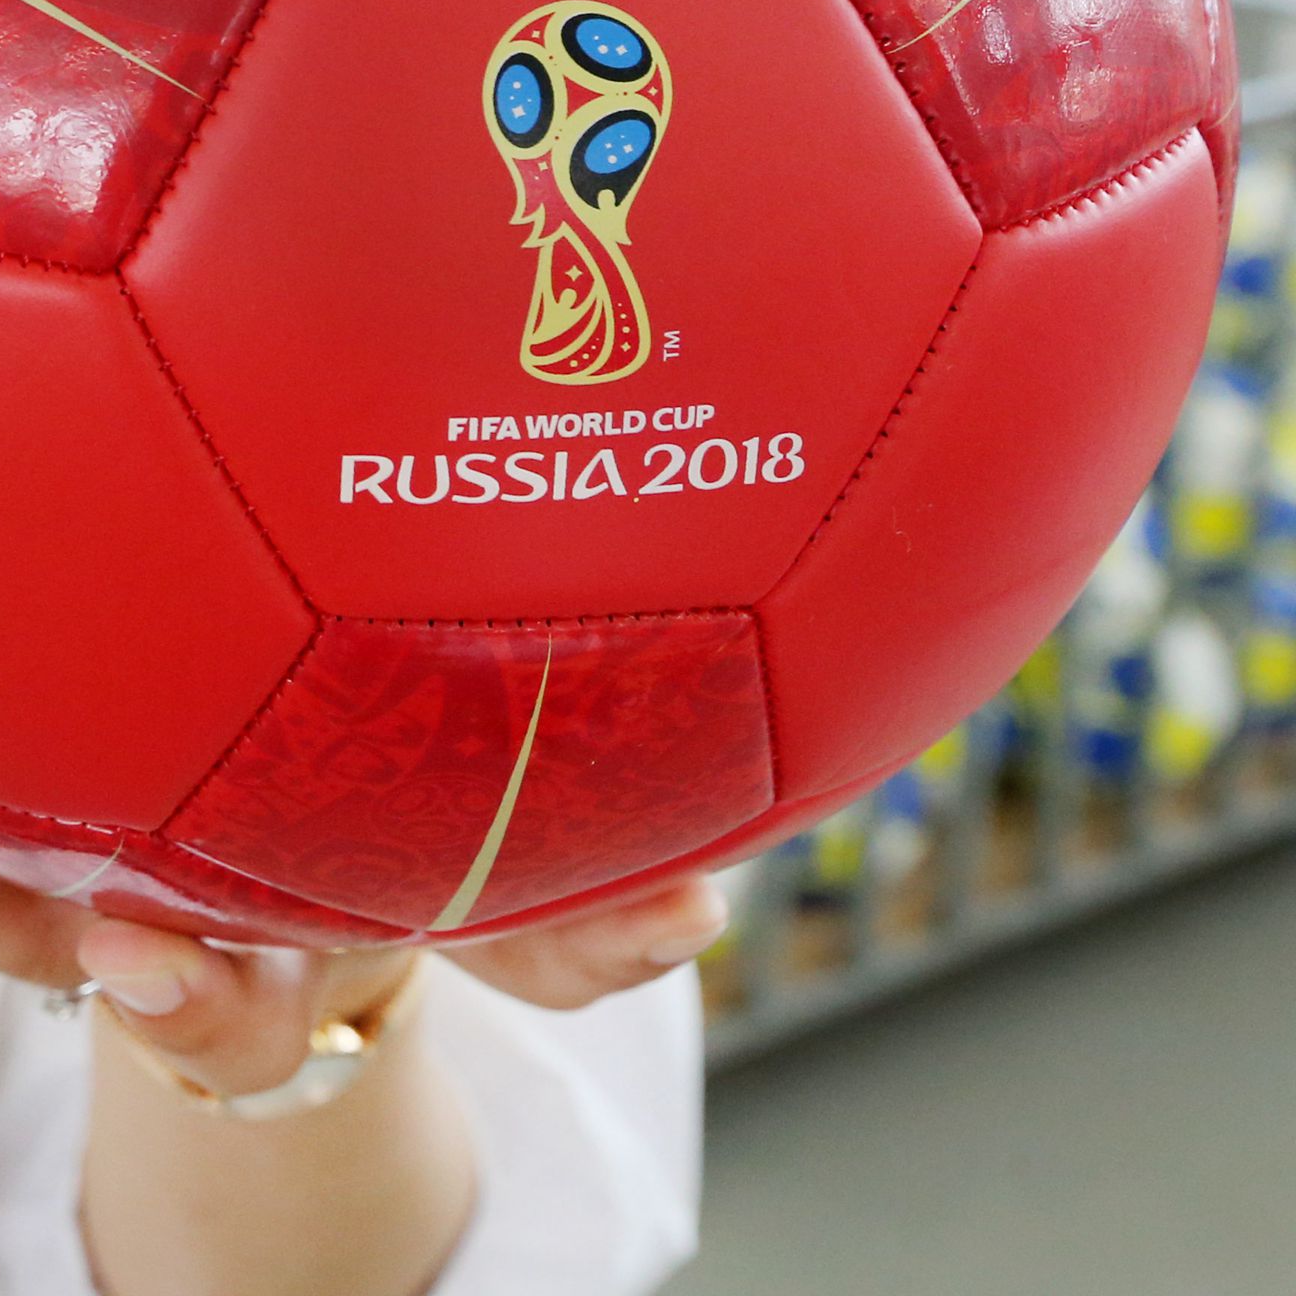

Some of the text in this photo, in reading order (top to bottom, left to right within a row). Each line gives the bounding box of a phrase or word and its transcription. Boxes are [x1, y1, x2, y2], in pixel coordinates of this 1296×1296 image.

[663, 330, 680, 362] TM
[448, 404, 715, 442] FIFA WORLD CUP
[340, 432, 805, 504] RUSSIA 2018
